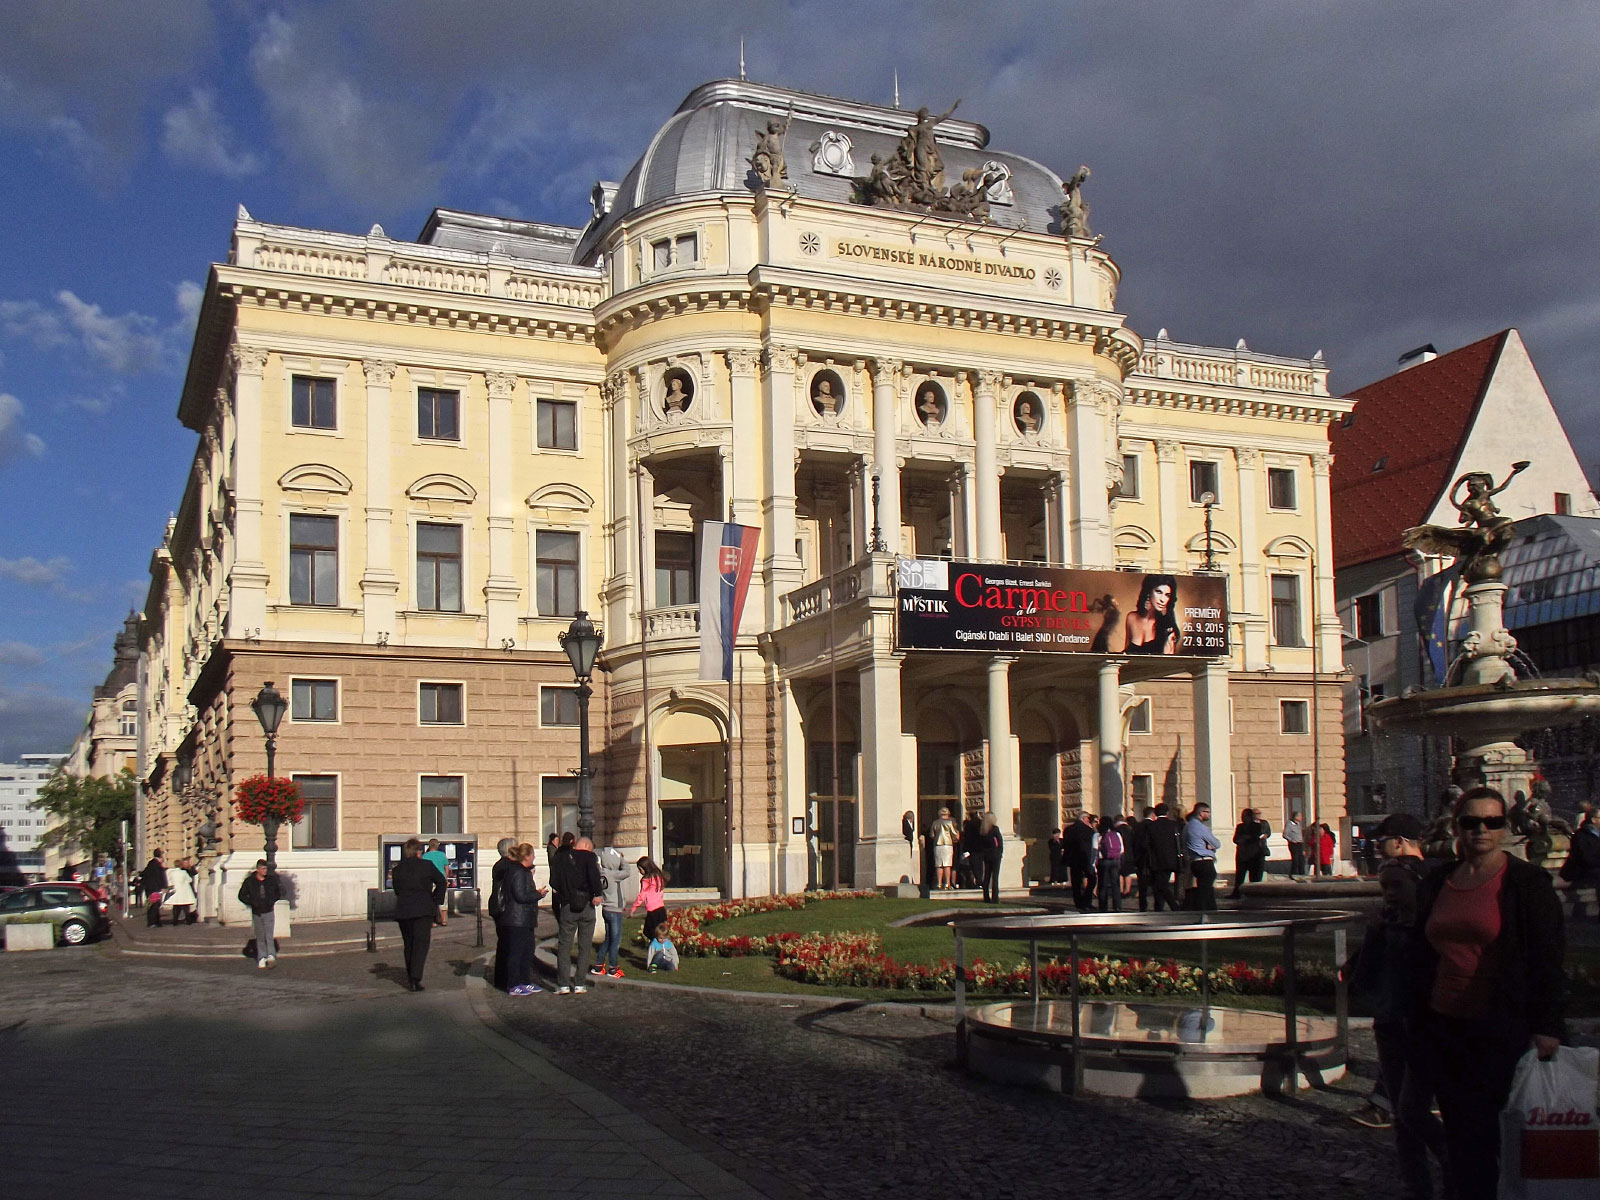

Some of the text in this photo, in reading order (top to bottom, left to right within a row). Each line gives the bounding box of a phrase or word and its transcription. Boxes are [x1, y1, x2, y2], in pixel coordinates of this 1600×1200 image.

[838, 242, 1036, 280] SLOVENSKÉ NÁRODNÉ DIVADLO
[954, 573, 1090, 613] Carmen
[1026, 600, 1037, 615] la
[1184, 606, 1222, 619] PREMIÉRY
[1001, 615, 1091, 631] GYPSY DEVILS
[1205, 622, 1224, 633] 2015
[955, 630, 987, 641] Cigánski
[988, 631, 1010, 641] Diabli
[1015, 632, 1035, 642] Balet
[1035, 633, 1051, 643] SND
[1057, 634, 1090, 644] Credance
[1205, 637, 1224, 648] 2015
